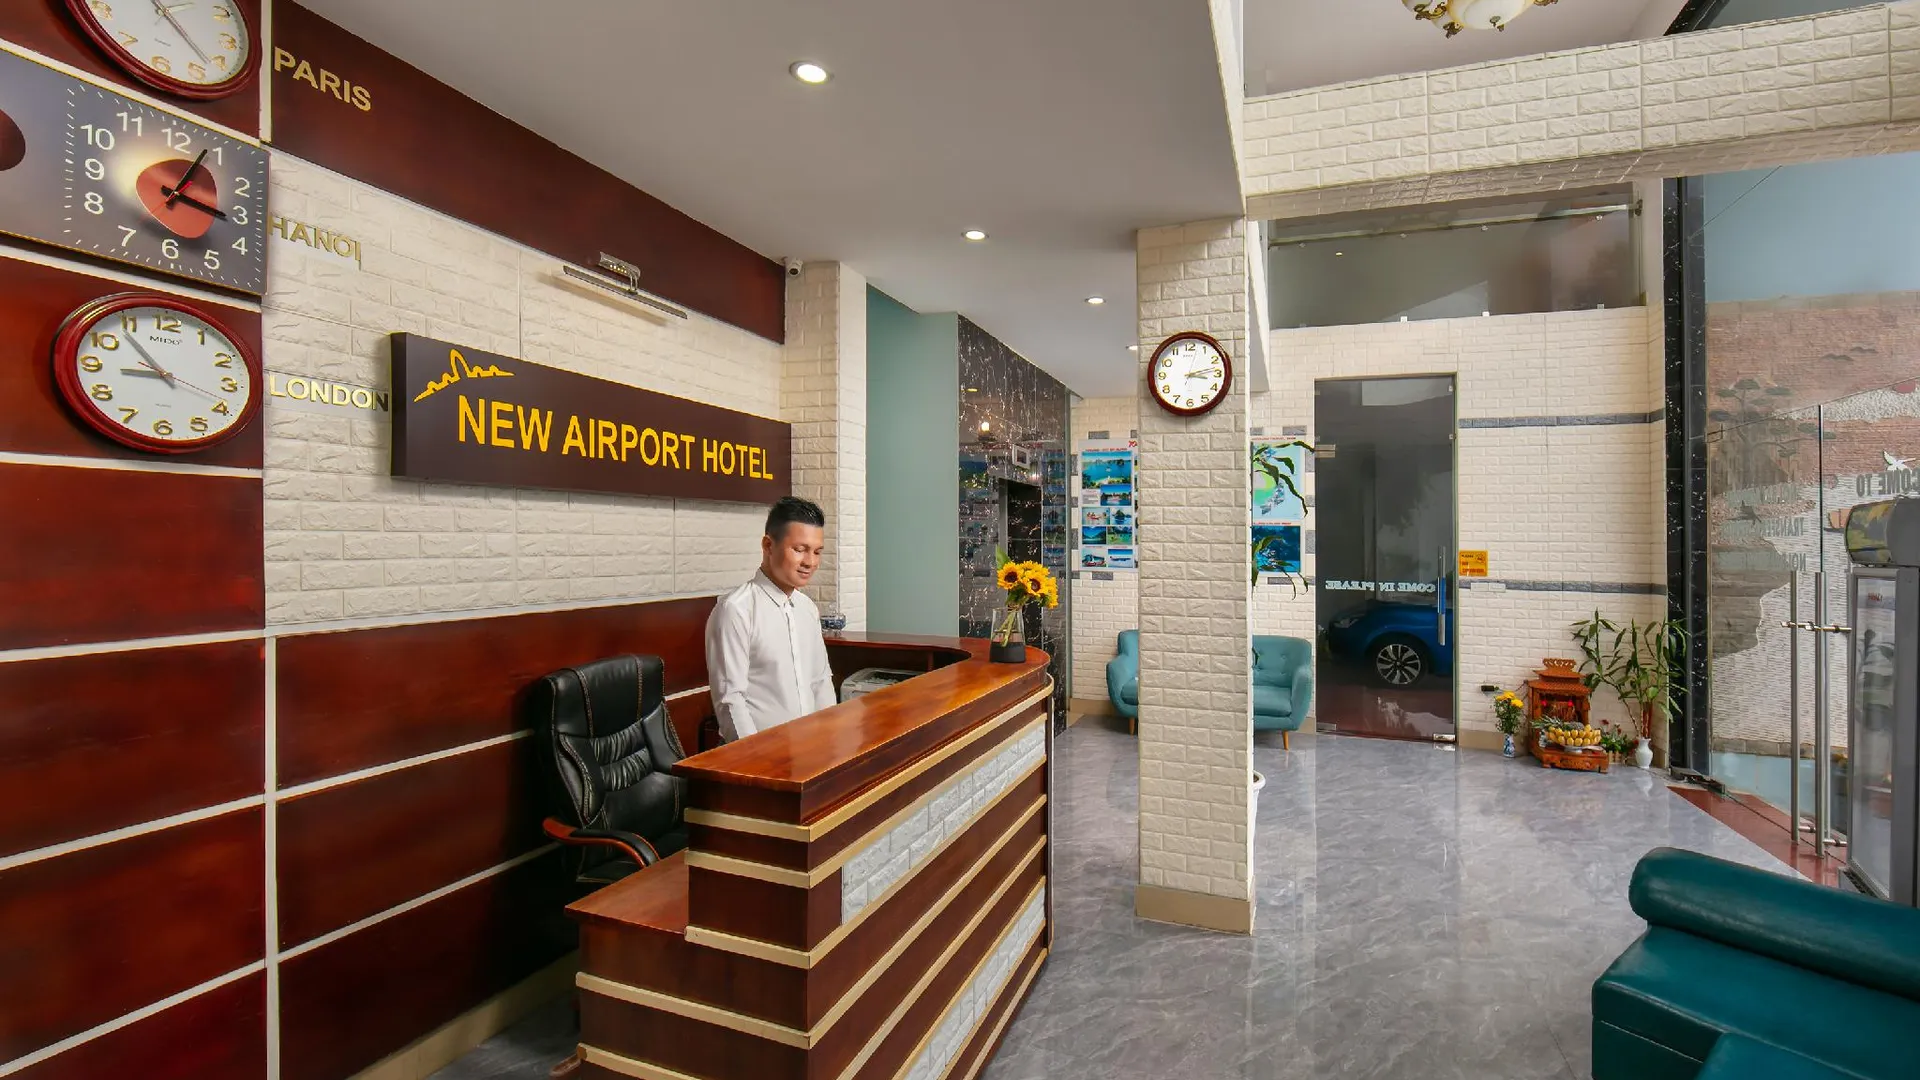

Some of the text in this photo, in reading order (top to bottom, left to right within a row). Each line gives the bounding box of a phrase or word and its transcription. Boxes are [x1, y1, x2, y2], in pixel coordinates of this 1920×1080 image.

[213, 5, 231, 24] 2
[118, 31, 139, 47] 7
[219, 32, 237, 50] 3
[152, 56, 171, 73] 6
[188, 62, 206, 80] 5
[274, 46, 371, 111] PARIS
[116, 111, 142, 137] 11
[80, 124, 115, 151] 10
[161, 128, 192, 154] 12
[212, 147, 222, 166] 1
[85, 158, 105, 181] 9
[234, 177, 250, 198] 2
[84, 192, 104, 215] 8
[232, 205, 249, 225] 3
[117, 225, 137, 247] 7
[267, 214, 361, 261] HANOI
[161, 239, 179, 259] 6
[231, 237, 248, 256] 4
[203, 249, 221, 270] 5
[119, 315, 137, 333] 11
[154, 313, 182, 333] 12
[90, 332, 120, 351] 10
[197, 328, 206, 345] 1
[1172, 347, 1179, 356] 11
[1185, 342, 1196, 352] 12
[1202, 346, 1207, 355] 1
[80, 355, 103, 373] 9
[213, 352, 232, 369] 2
[1161, 358, 1173, 368] 10
[1211, 355, 1219, 365] 2
[1158, 371, 1167, 380] 9
[1213, 369, 1222, 378] 3
[91, 384, 113, 401] 8
[220, 377, 238, 393] 3
[269, 371, 388, 412] LONDON
[1162, 384, 1171, 394] 8
[1210, 382, 1218, 392] 4
[211, 400, 229, 416] 4
[1172, 395, 1181, 404] 7
[1186, 398, 1195, 407] 6
[1200, 394, 1210, 404] 5
[117, 406, 139, 424] 7
[153, 419, 173, 436] 6
[189, 416, 209, 433] 5
[458, 394, 773, 480] NEW AIRPORT HOTEL
